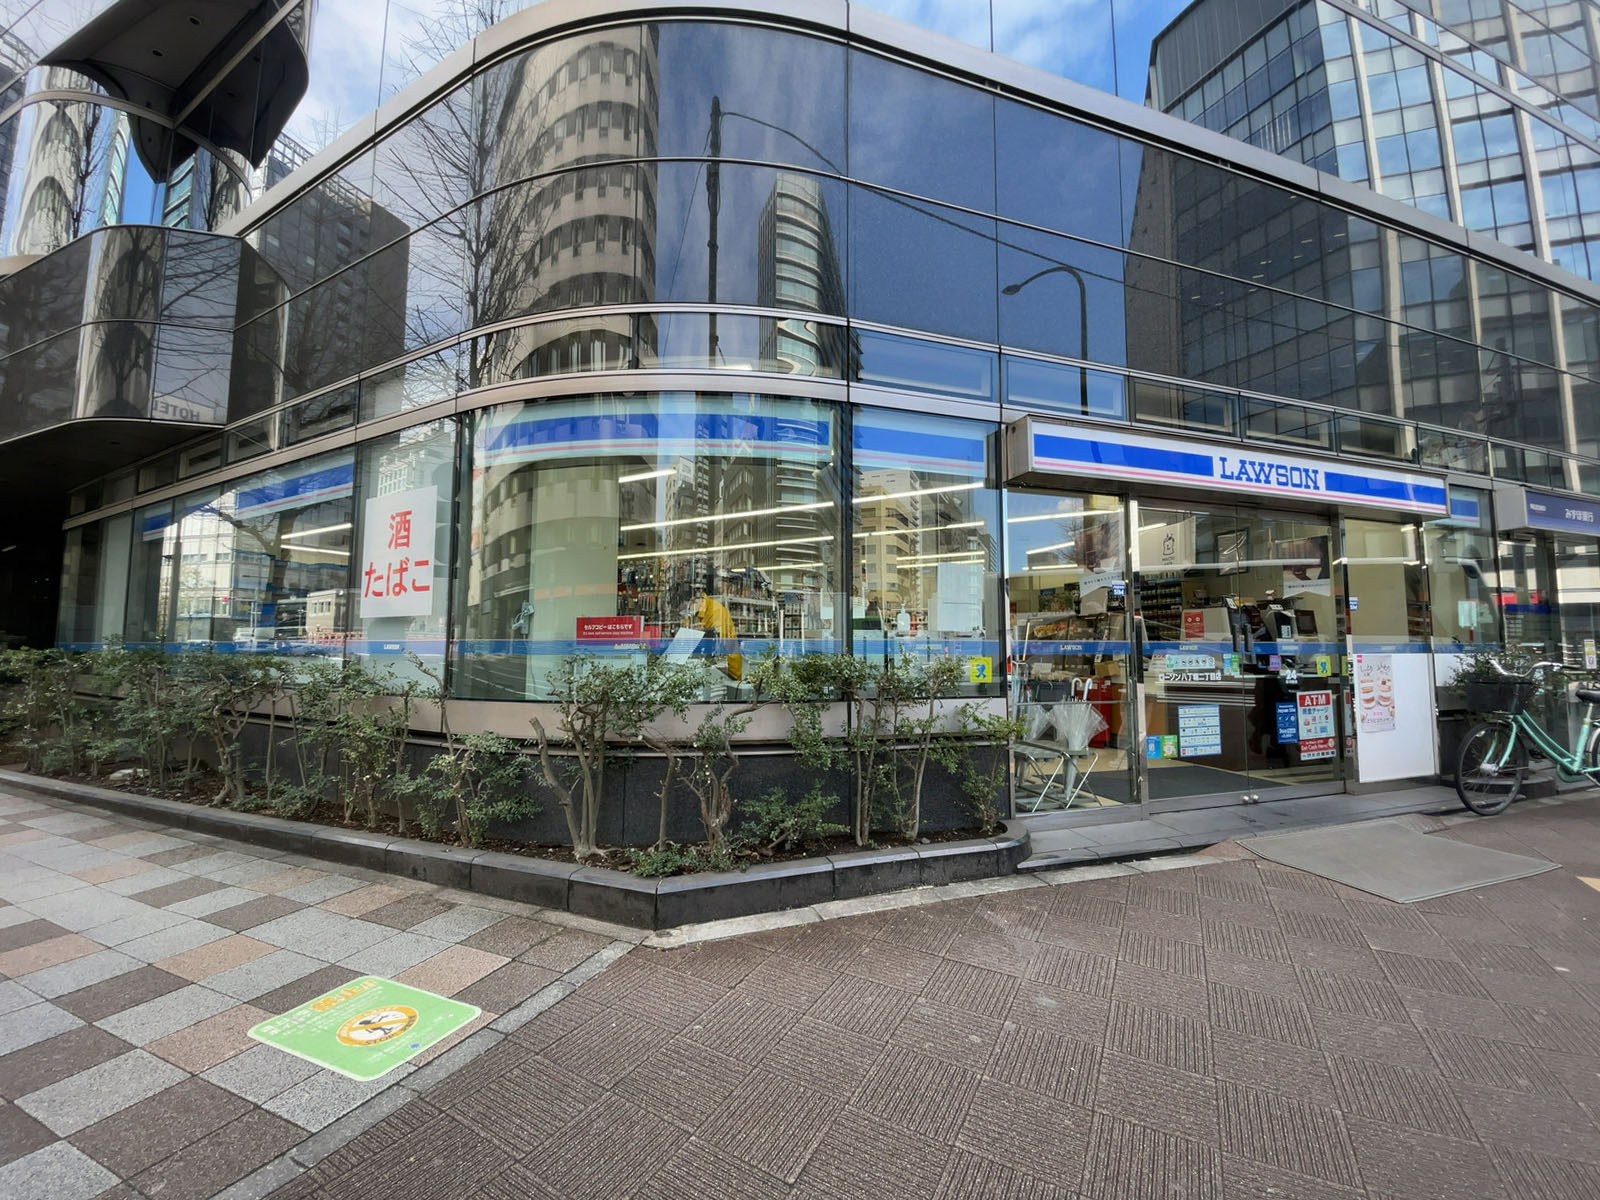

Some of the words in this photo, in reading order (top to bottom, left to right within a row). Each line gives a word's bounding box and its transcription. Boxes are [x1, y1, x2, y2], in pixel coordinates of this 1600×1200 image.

[1219, 456, 1320, 491] LAWSON
[388, 510, 413, 549] 酒
[364, 556, 431, 598] たばこ
[1286, 669, 1297, 680] 24
[1304, 694, 1326, 706] ATM
